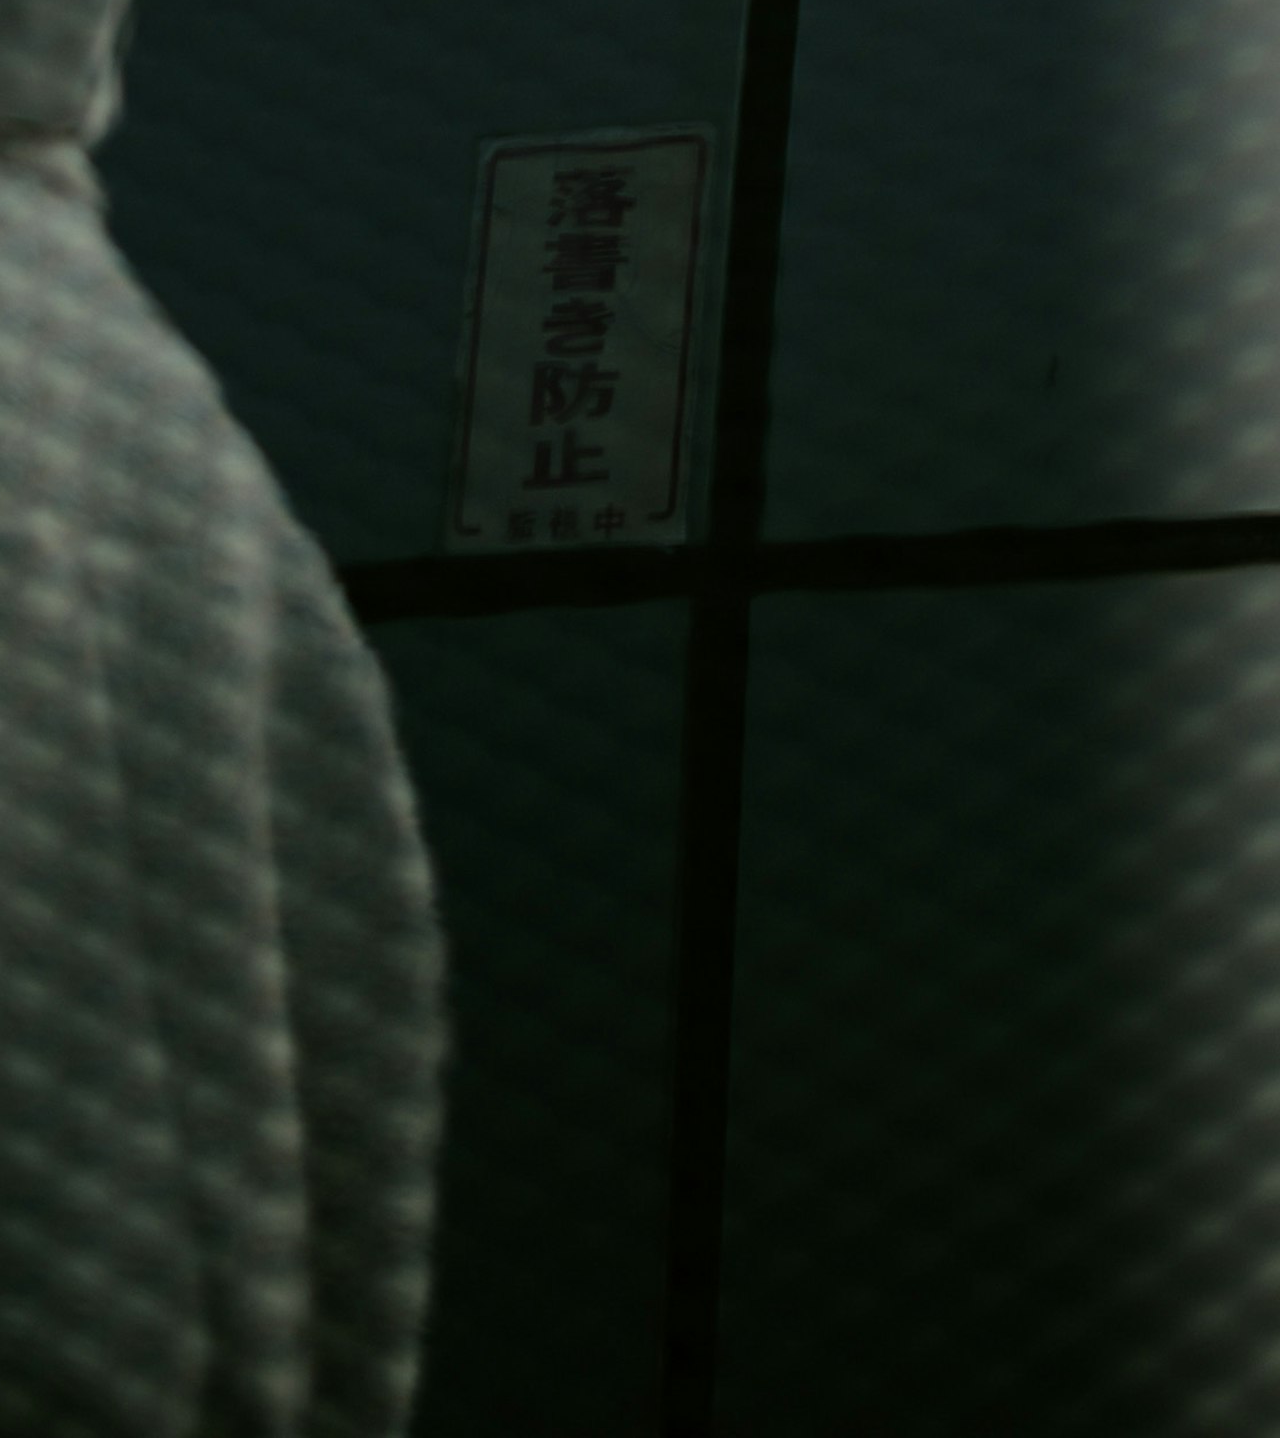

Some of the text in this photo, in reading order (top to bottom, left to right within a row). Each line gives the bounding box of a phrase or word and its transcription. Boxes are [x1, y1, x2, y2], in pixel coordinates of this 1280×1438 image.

[522, 165, 636, 490] 落書き防止
